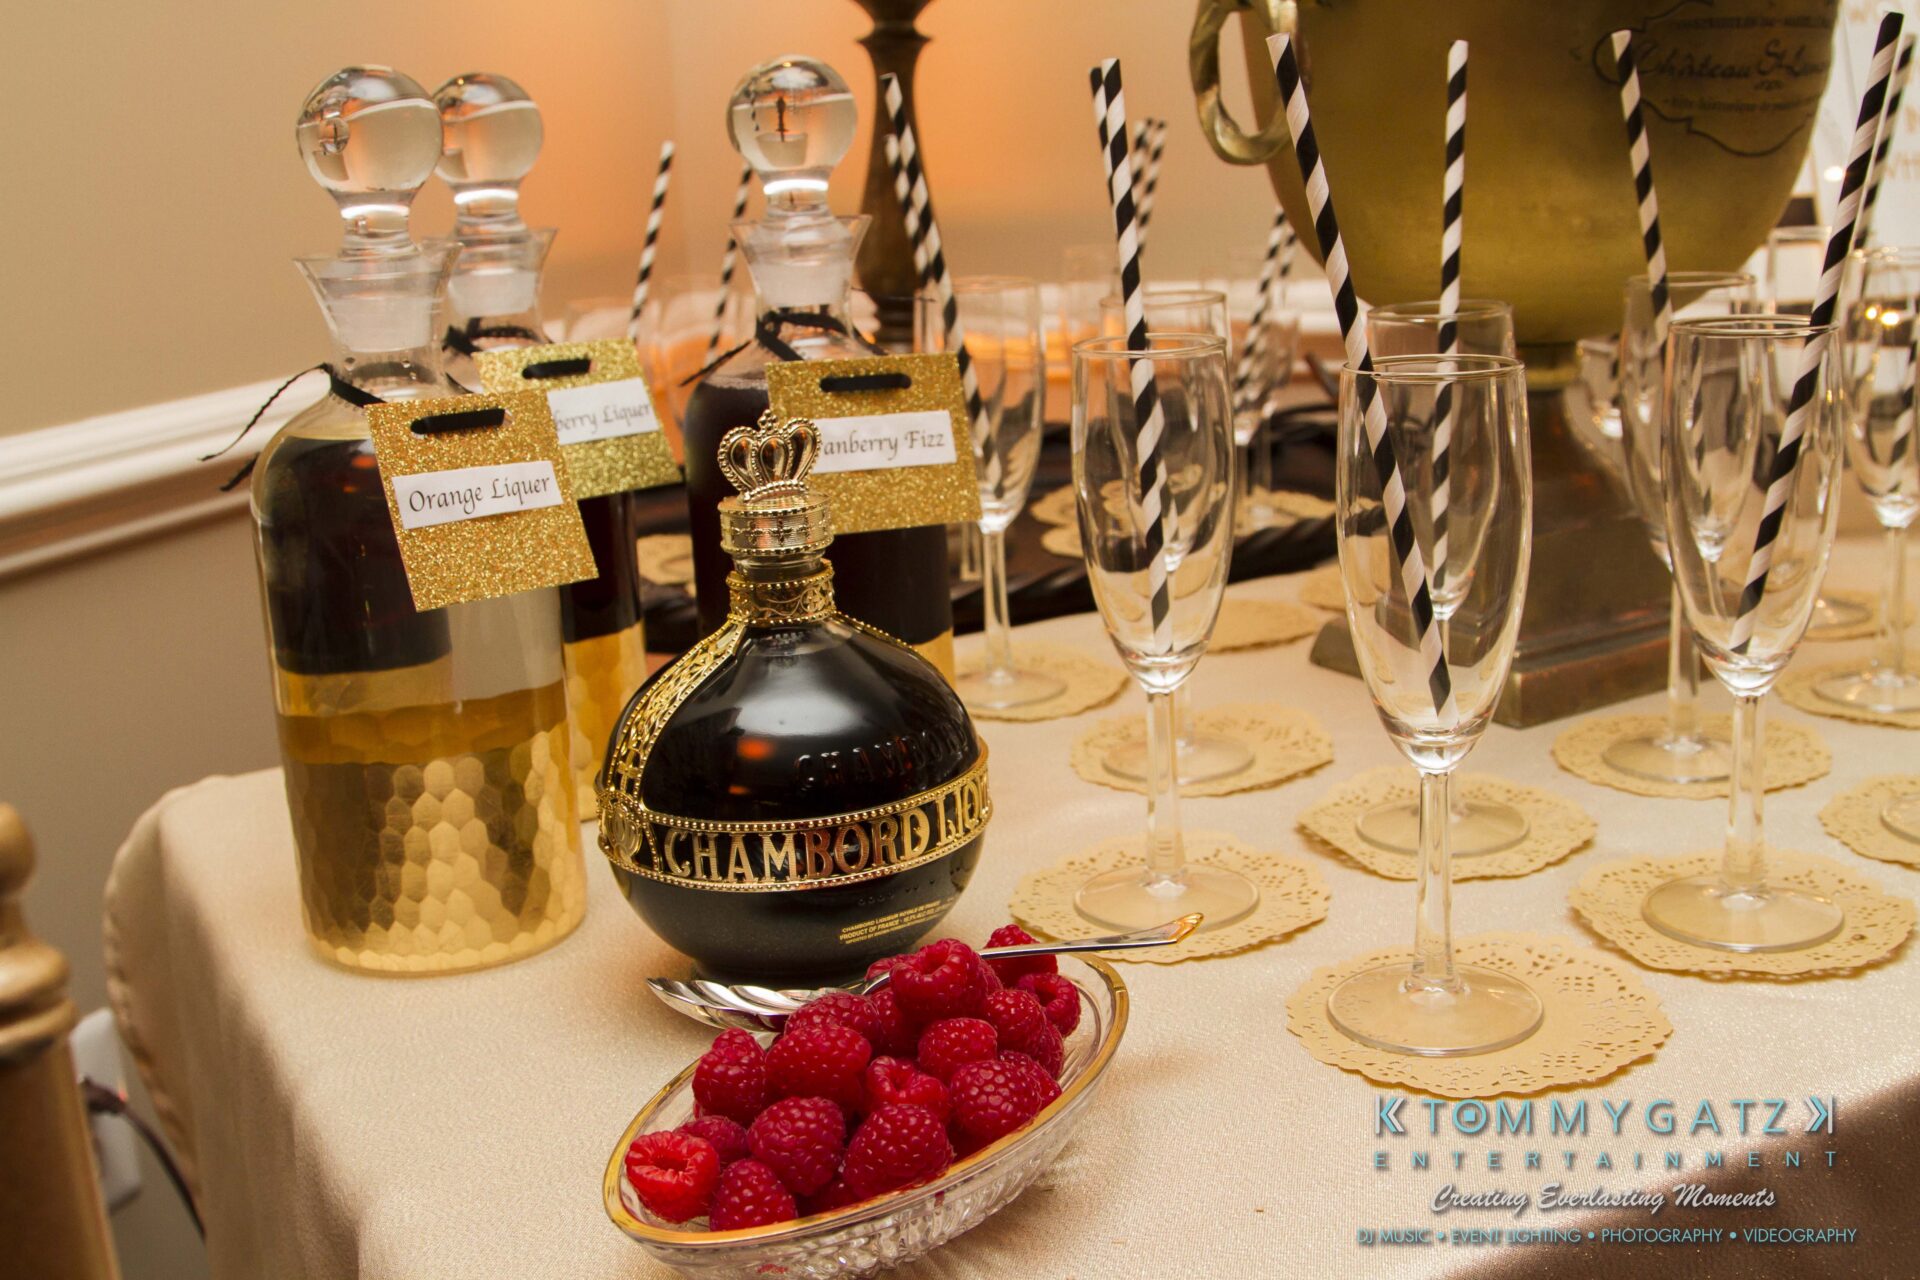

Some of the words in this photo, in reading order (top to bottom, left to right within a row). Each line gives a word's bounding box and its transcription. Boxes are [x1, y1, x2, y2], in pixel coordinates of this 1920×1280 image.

[554, 408, 599, 435] berry
[602, 402, 650, 427] Liquer
[821, 430, 899, 461] anberry
[904, 430, 946, 450] Fizz
[408, 486, 485, 515] Orange
[491, 476, 551, 506] Liquer
[664, 806, 931, 883] CHAMBORD
[840, 927, 869, 941] PRODUCT
[869, 925, 878, 933] OF
[878, 919, 900, 931] FRANCE
[842, 920, 876, 934] CHAMBORD
